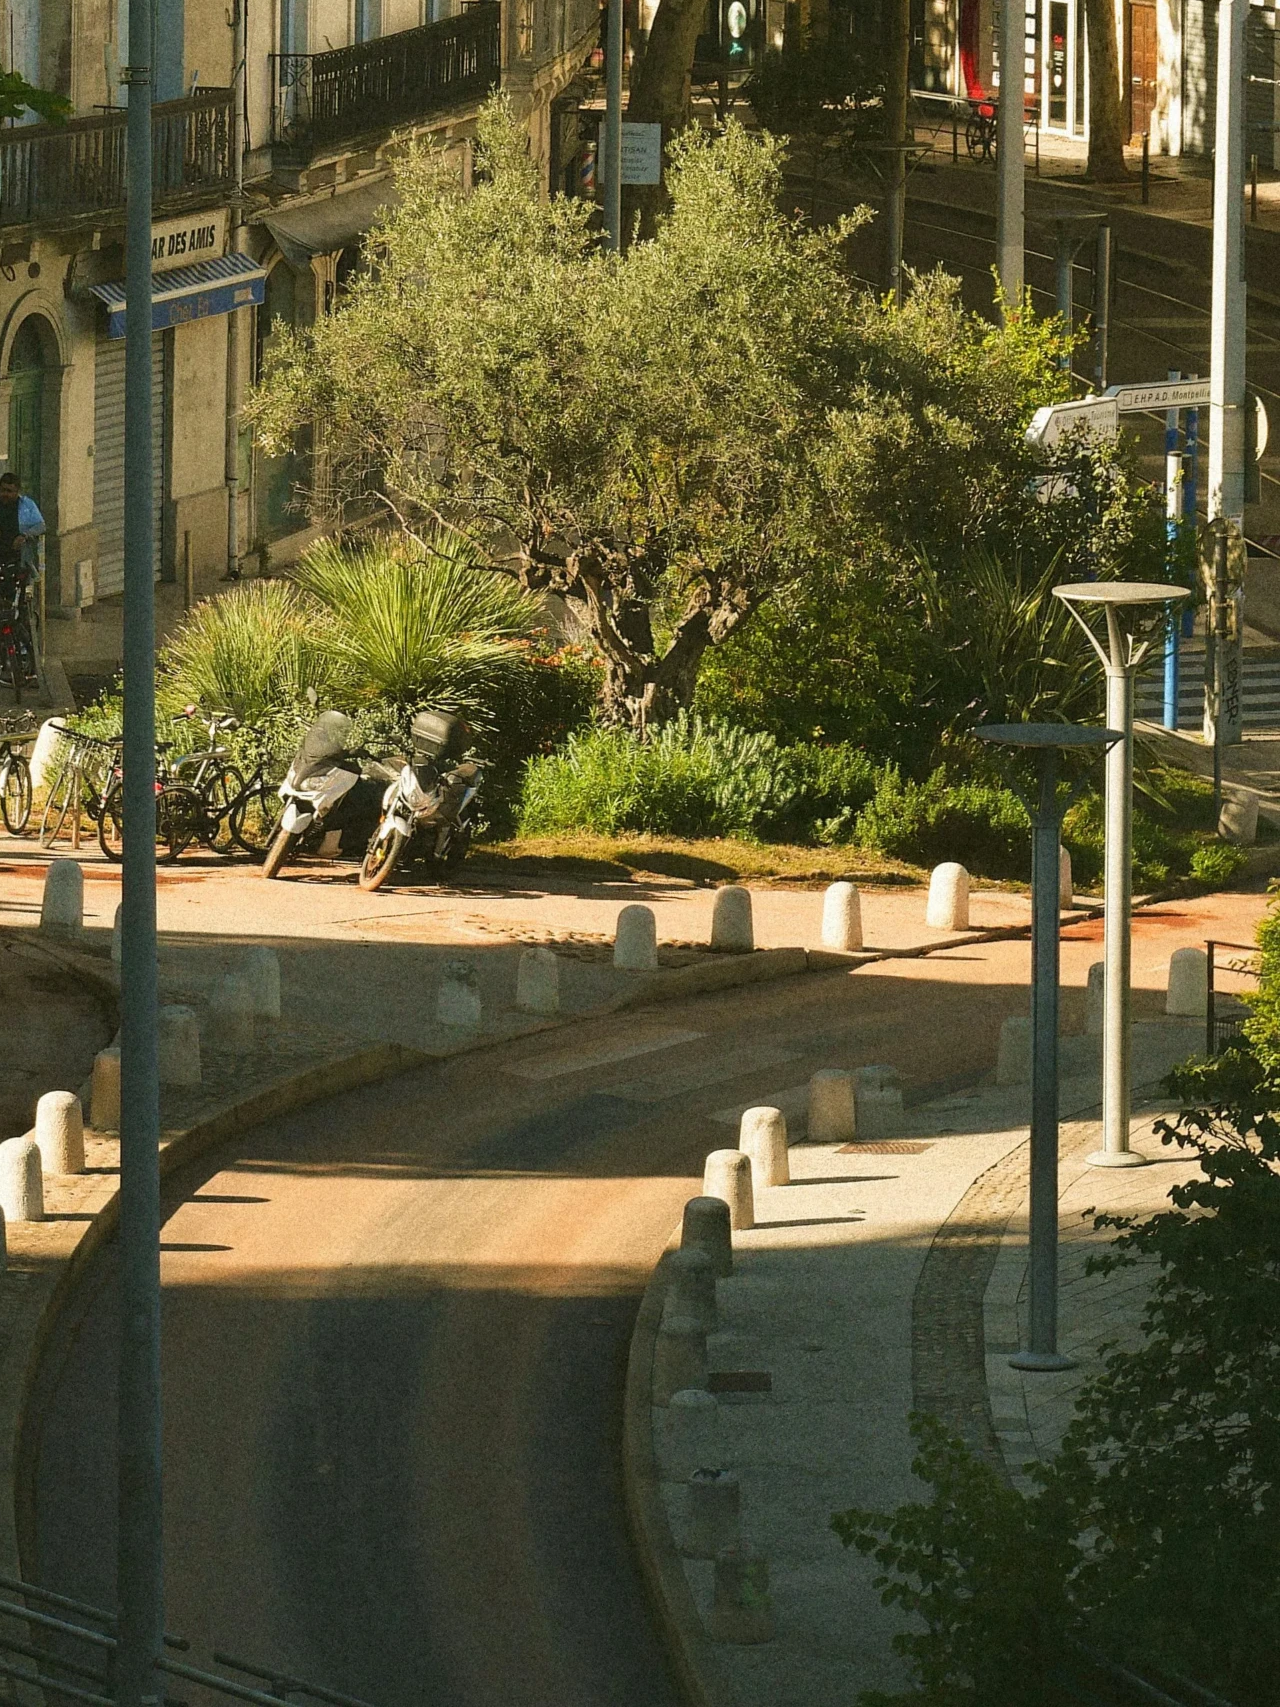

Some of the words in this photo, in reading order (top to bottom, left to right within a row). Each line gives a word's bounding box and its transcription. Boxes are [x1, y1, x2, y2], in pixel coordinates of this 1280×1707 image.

[151, 236, 166, 260] AR
[168, 230, 187, 256] DES
[188, 224, 216, 251] AMIS
